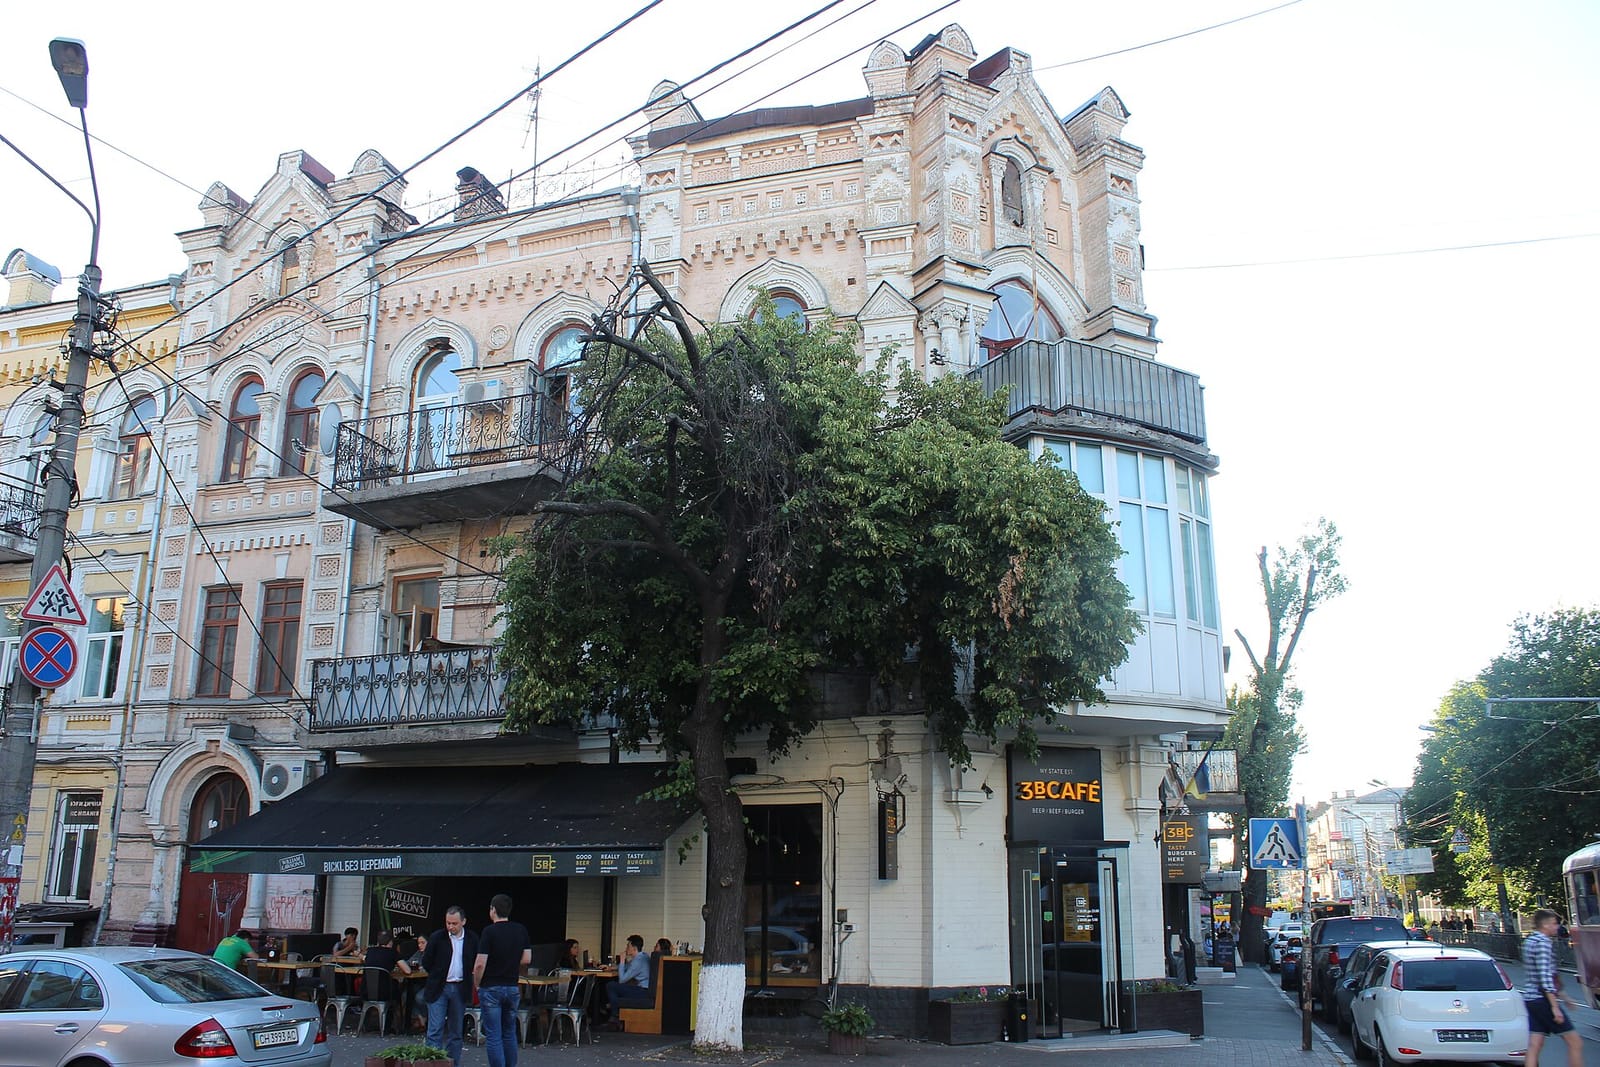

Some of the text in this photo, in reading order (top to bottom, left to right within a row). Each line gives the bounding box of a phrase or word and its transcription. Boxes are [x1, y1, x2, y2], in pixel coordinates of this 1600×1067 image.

[1168, 827, 1195, 838] 3BC
[345, 860, 359, 872] БЕЗ
[360, 856, 402, 871] ЦЕРЕМОНІЙ
[389, 890, 424, 905] WILLIAM
